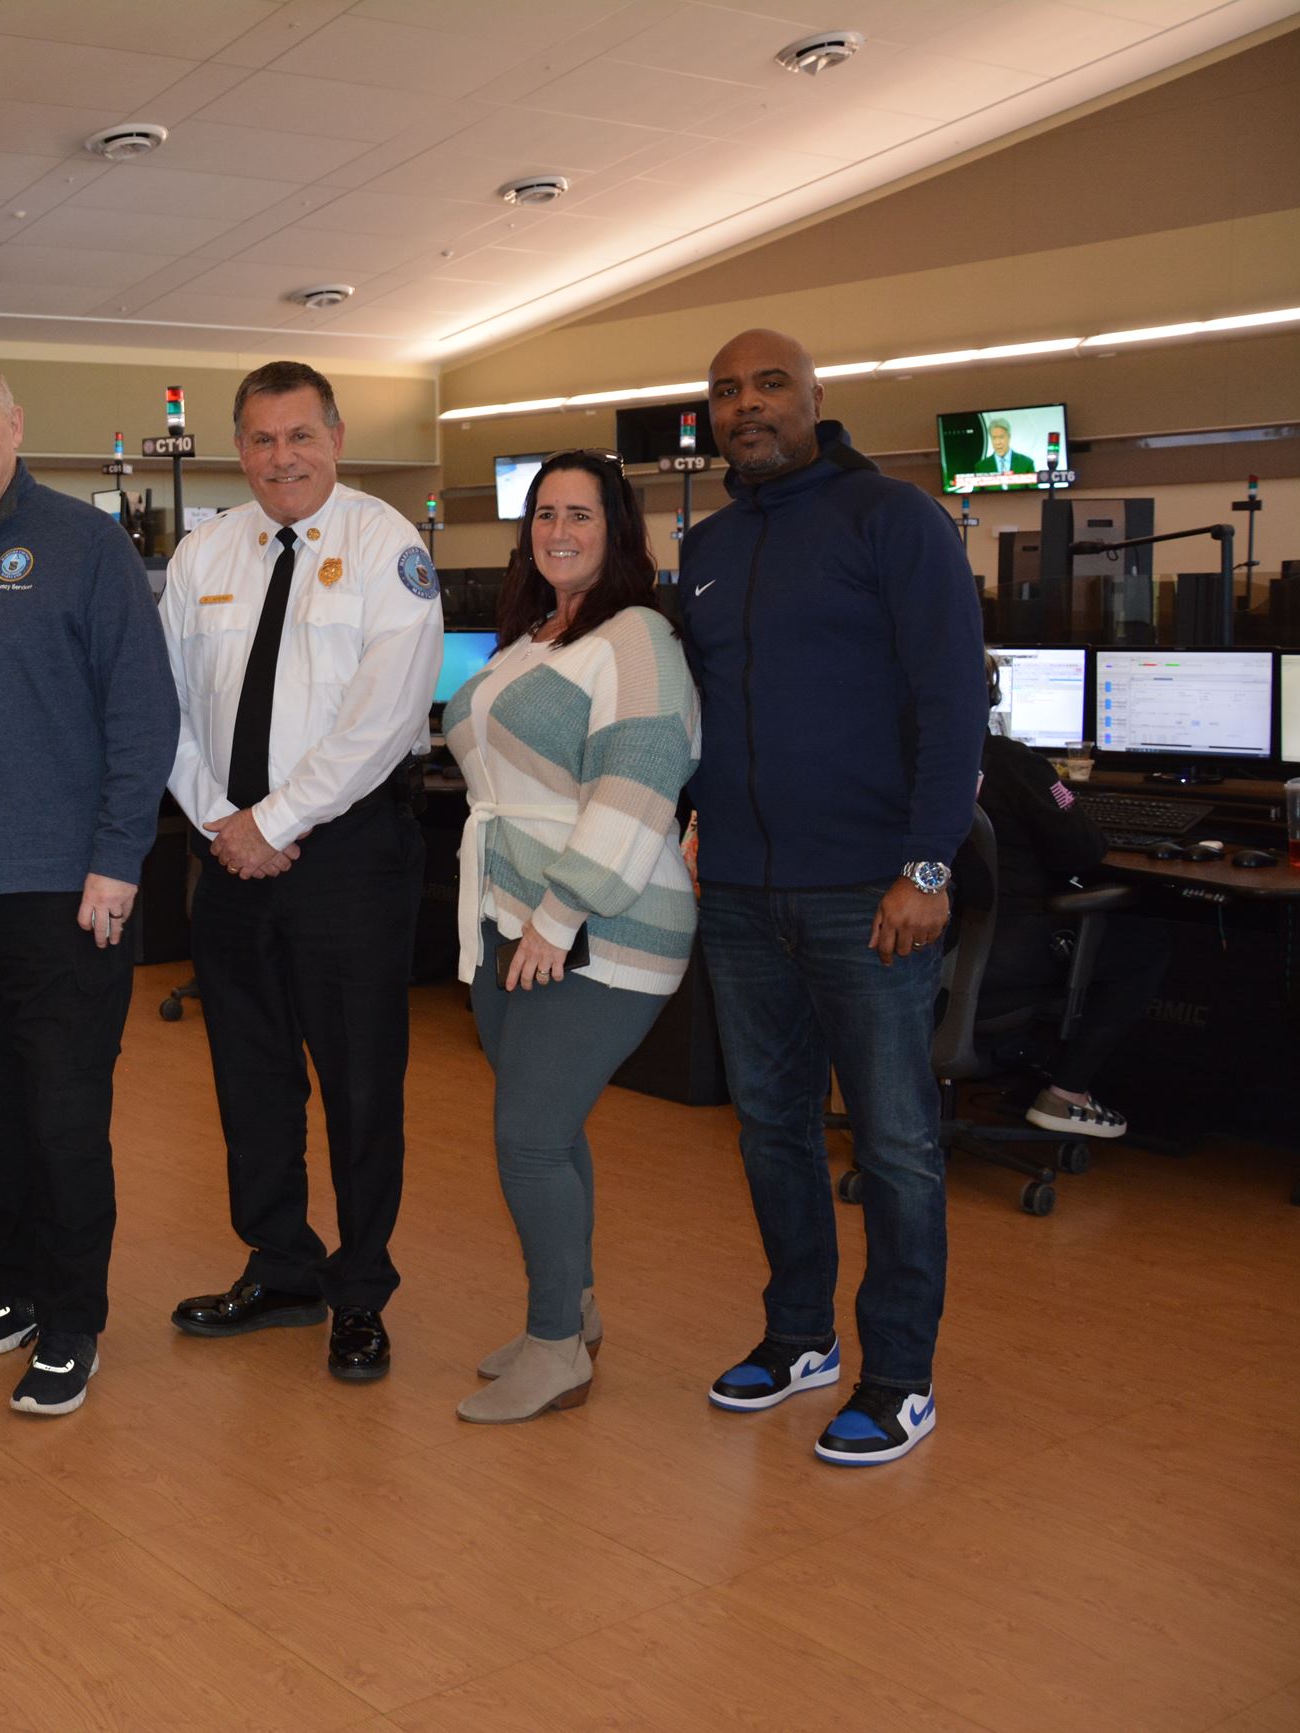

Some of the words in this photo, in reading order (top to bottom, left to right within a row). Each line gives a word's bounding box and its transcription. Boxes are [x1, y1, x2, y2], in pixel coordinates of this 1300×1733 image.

[155, 437, 192, 453] CT10
[674, 456, 705, 469] CT9
[1051, 471, 1076, 482] CT6
